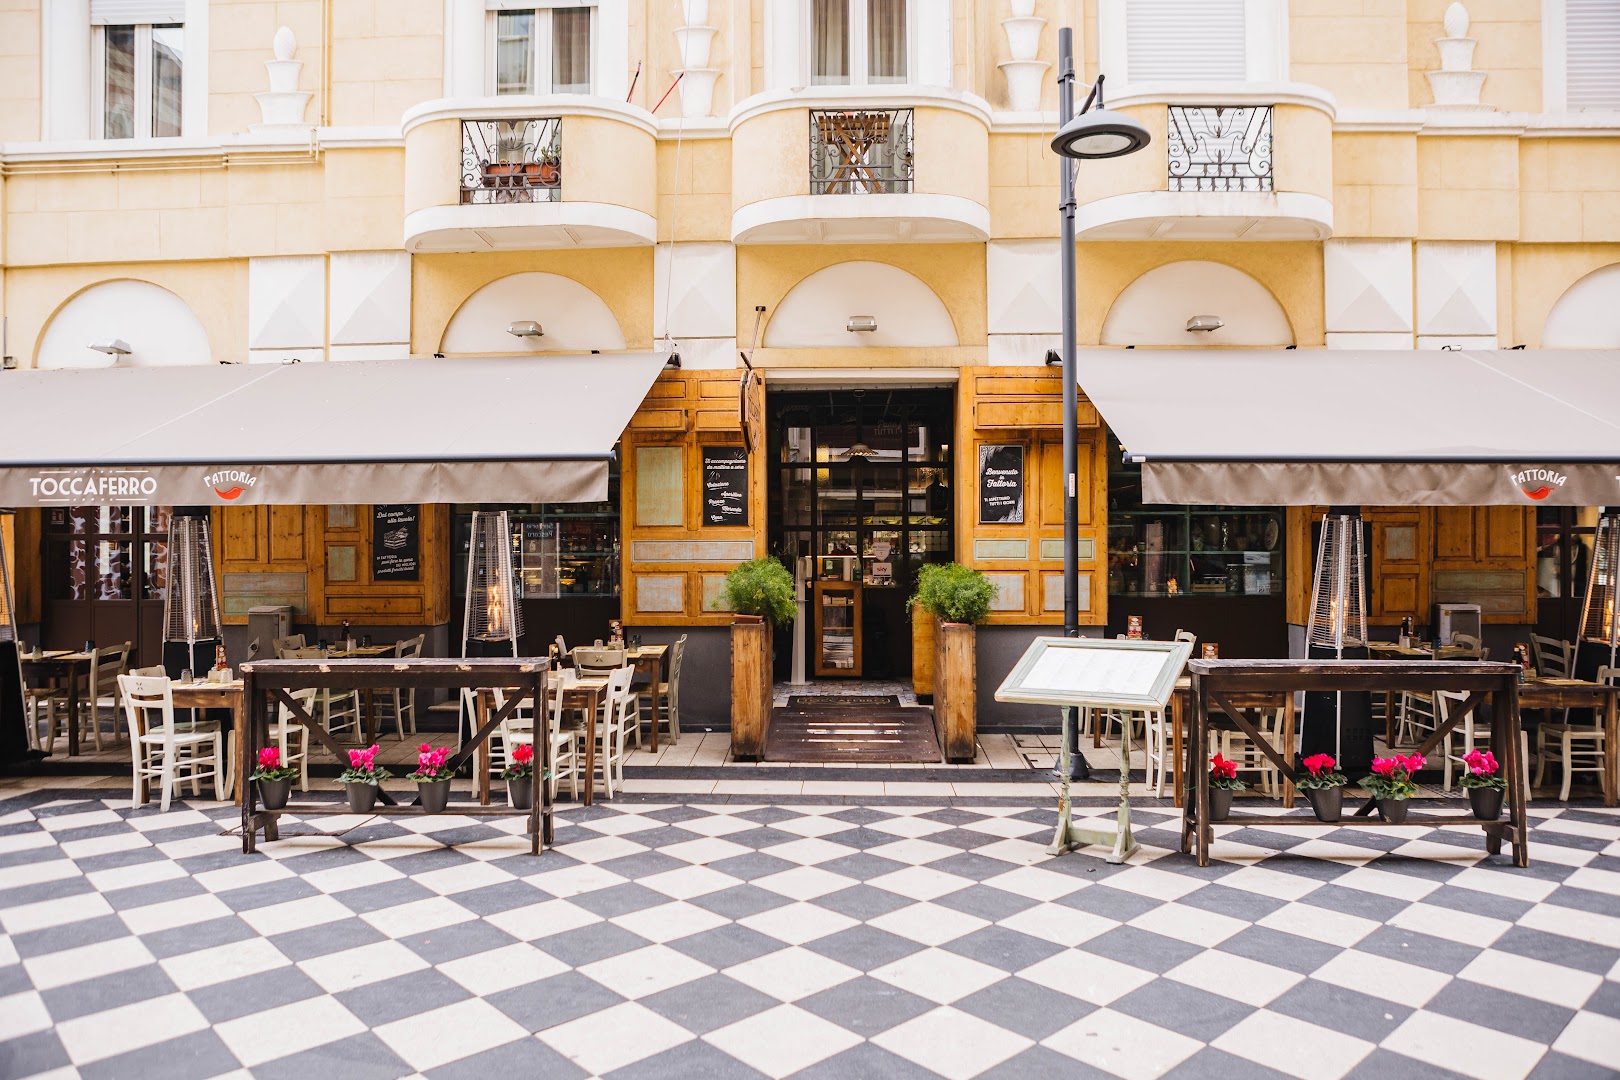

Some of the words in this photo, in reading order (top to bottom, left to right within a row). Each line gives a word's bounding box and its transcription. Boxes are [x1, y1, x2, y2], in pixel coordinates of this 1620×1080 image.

[29, 477, 158, 496] TOCCAFERRO
[203, 470, 257, 487] FATTORIA
[987, 479, 1017, 488] Fattoria
[1510, 468, 1568, 487] FATTORIA
